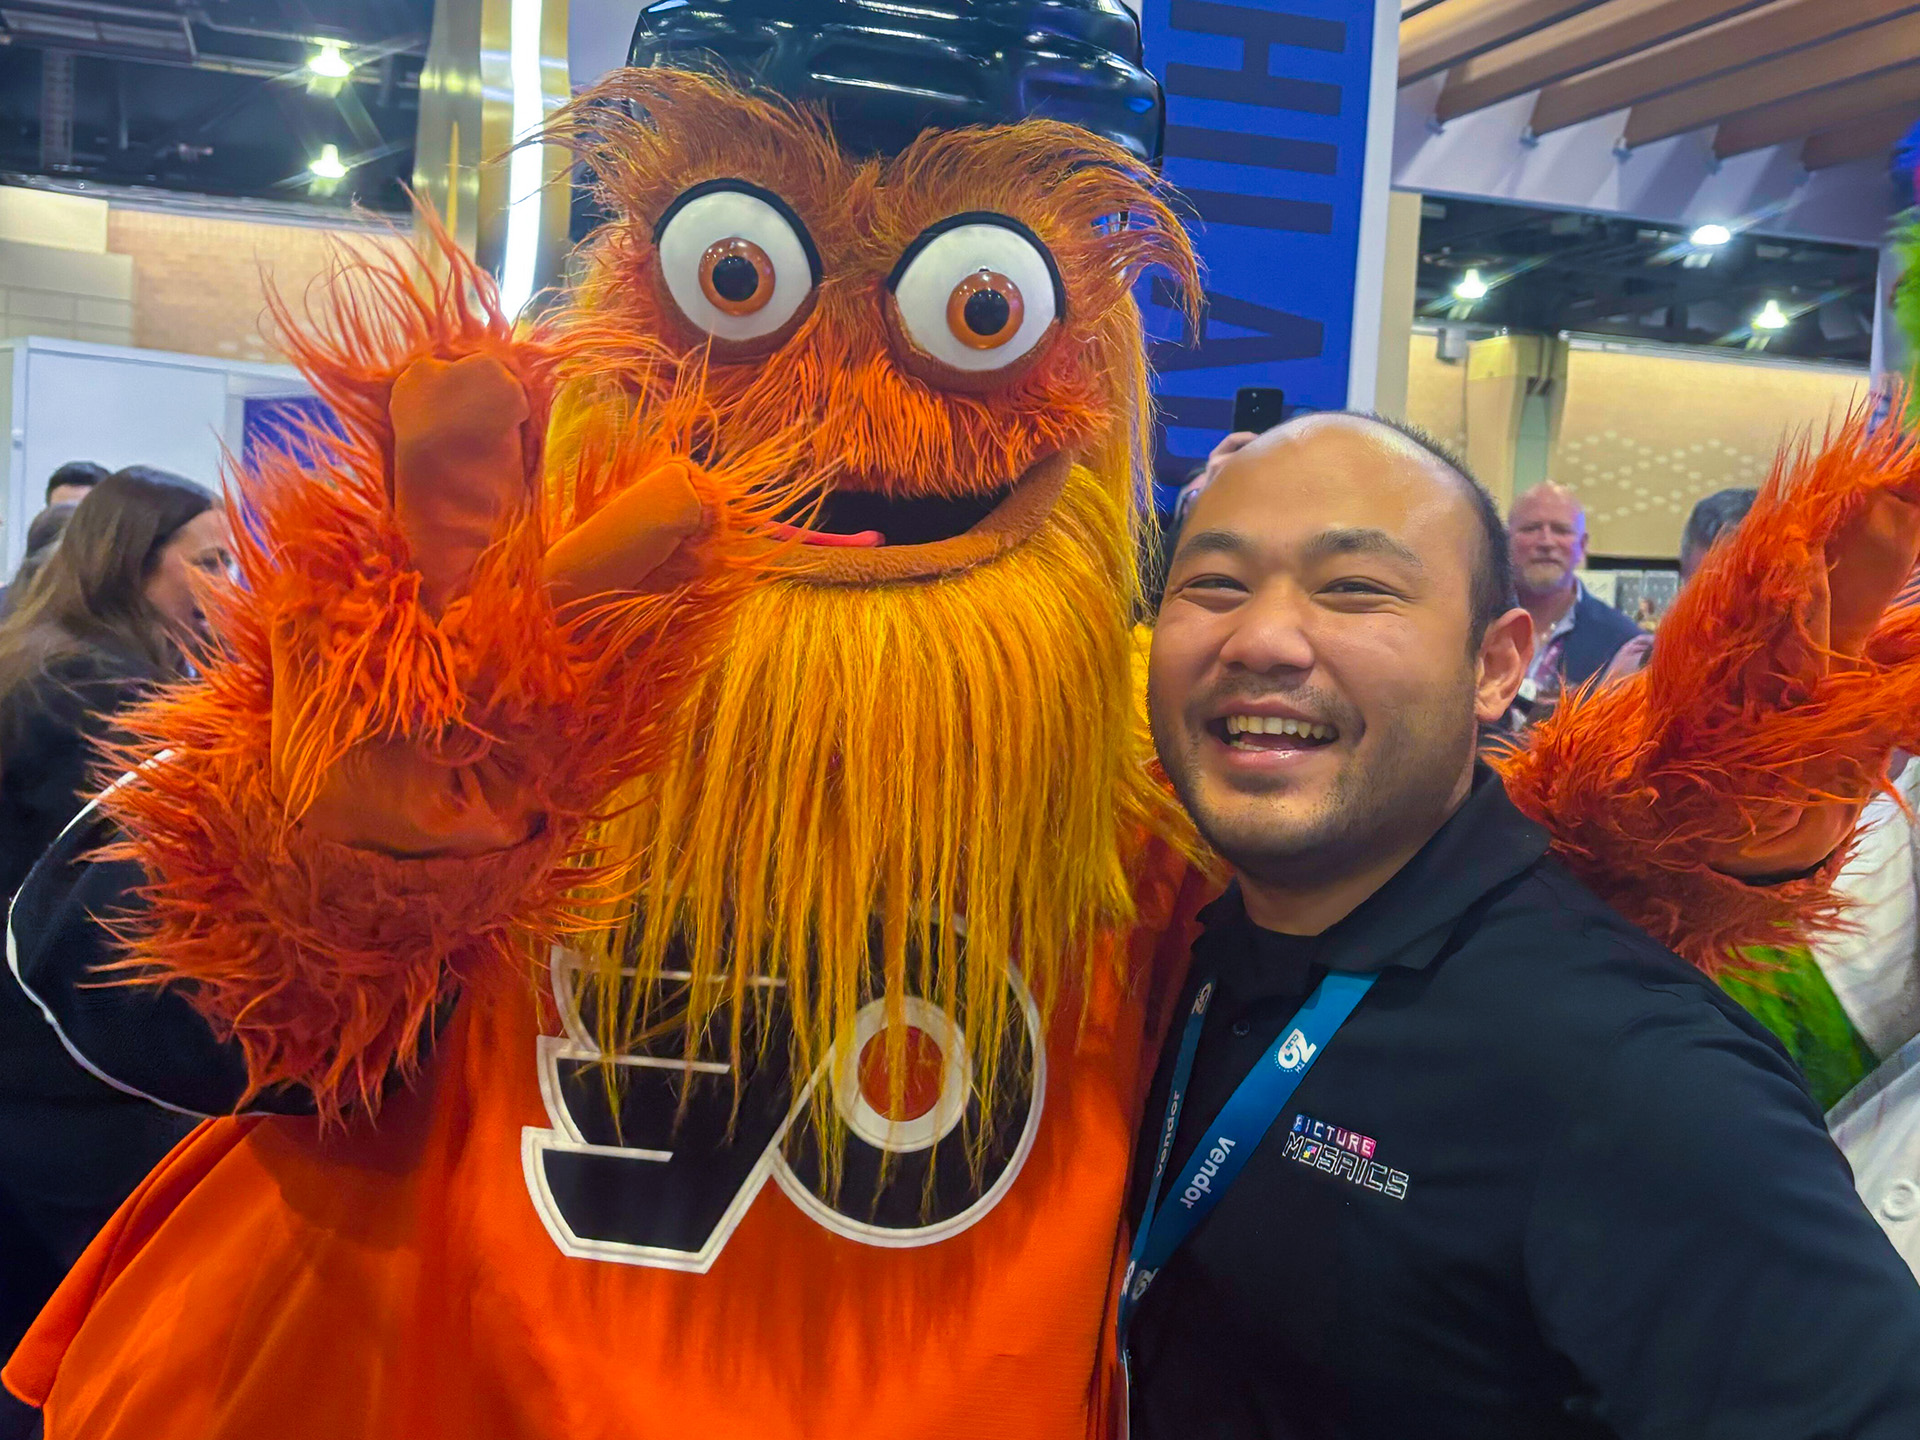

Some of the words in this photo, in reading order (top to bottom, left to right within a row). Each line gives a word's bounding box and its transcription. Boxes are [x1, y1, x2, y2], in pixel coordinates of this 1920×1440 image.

[1156, 1090, 1180, 1177] vendor
[1281, 1131, 1410, 1200] MOSAICS
[1292, 1114, 1376, 1157] PICTURE
[1179, 1136, 1236, 1209] vendor
